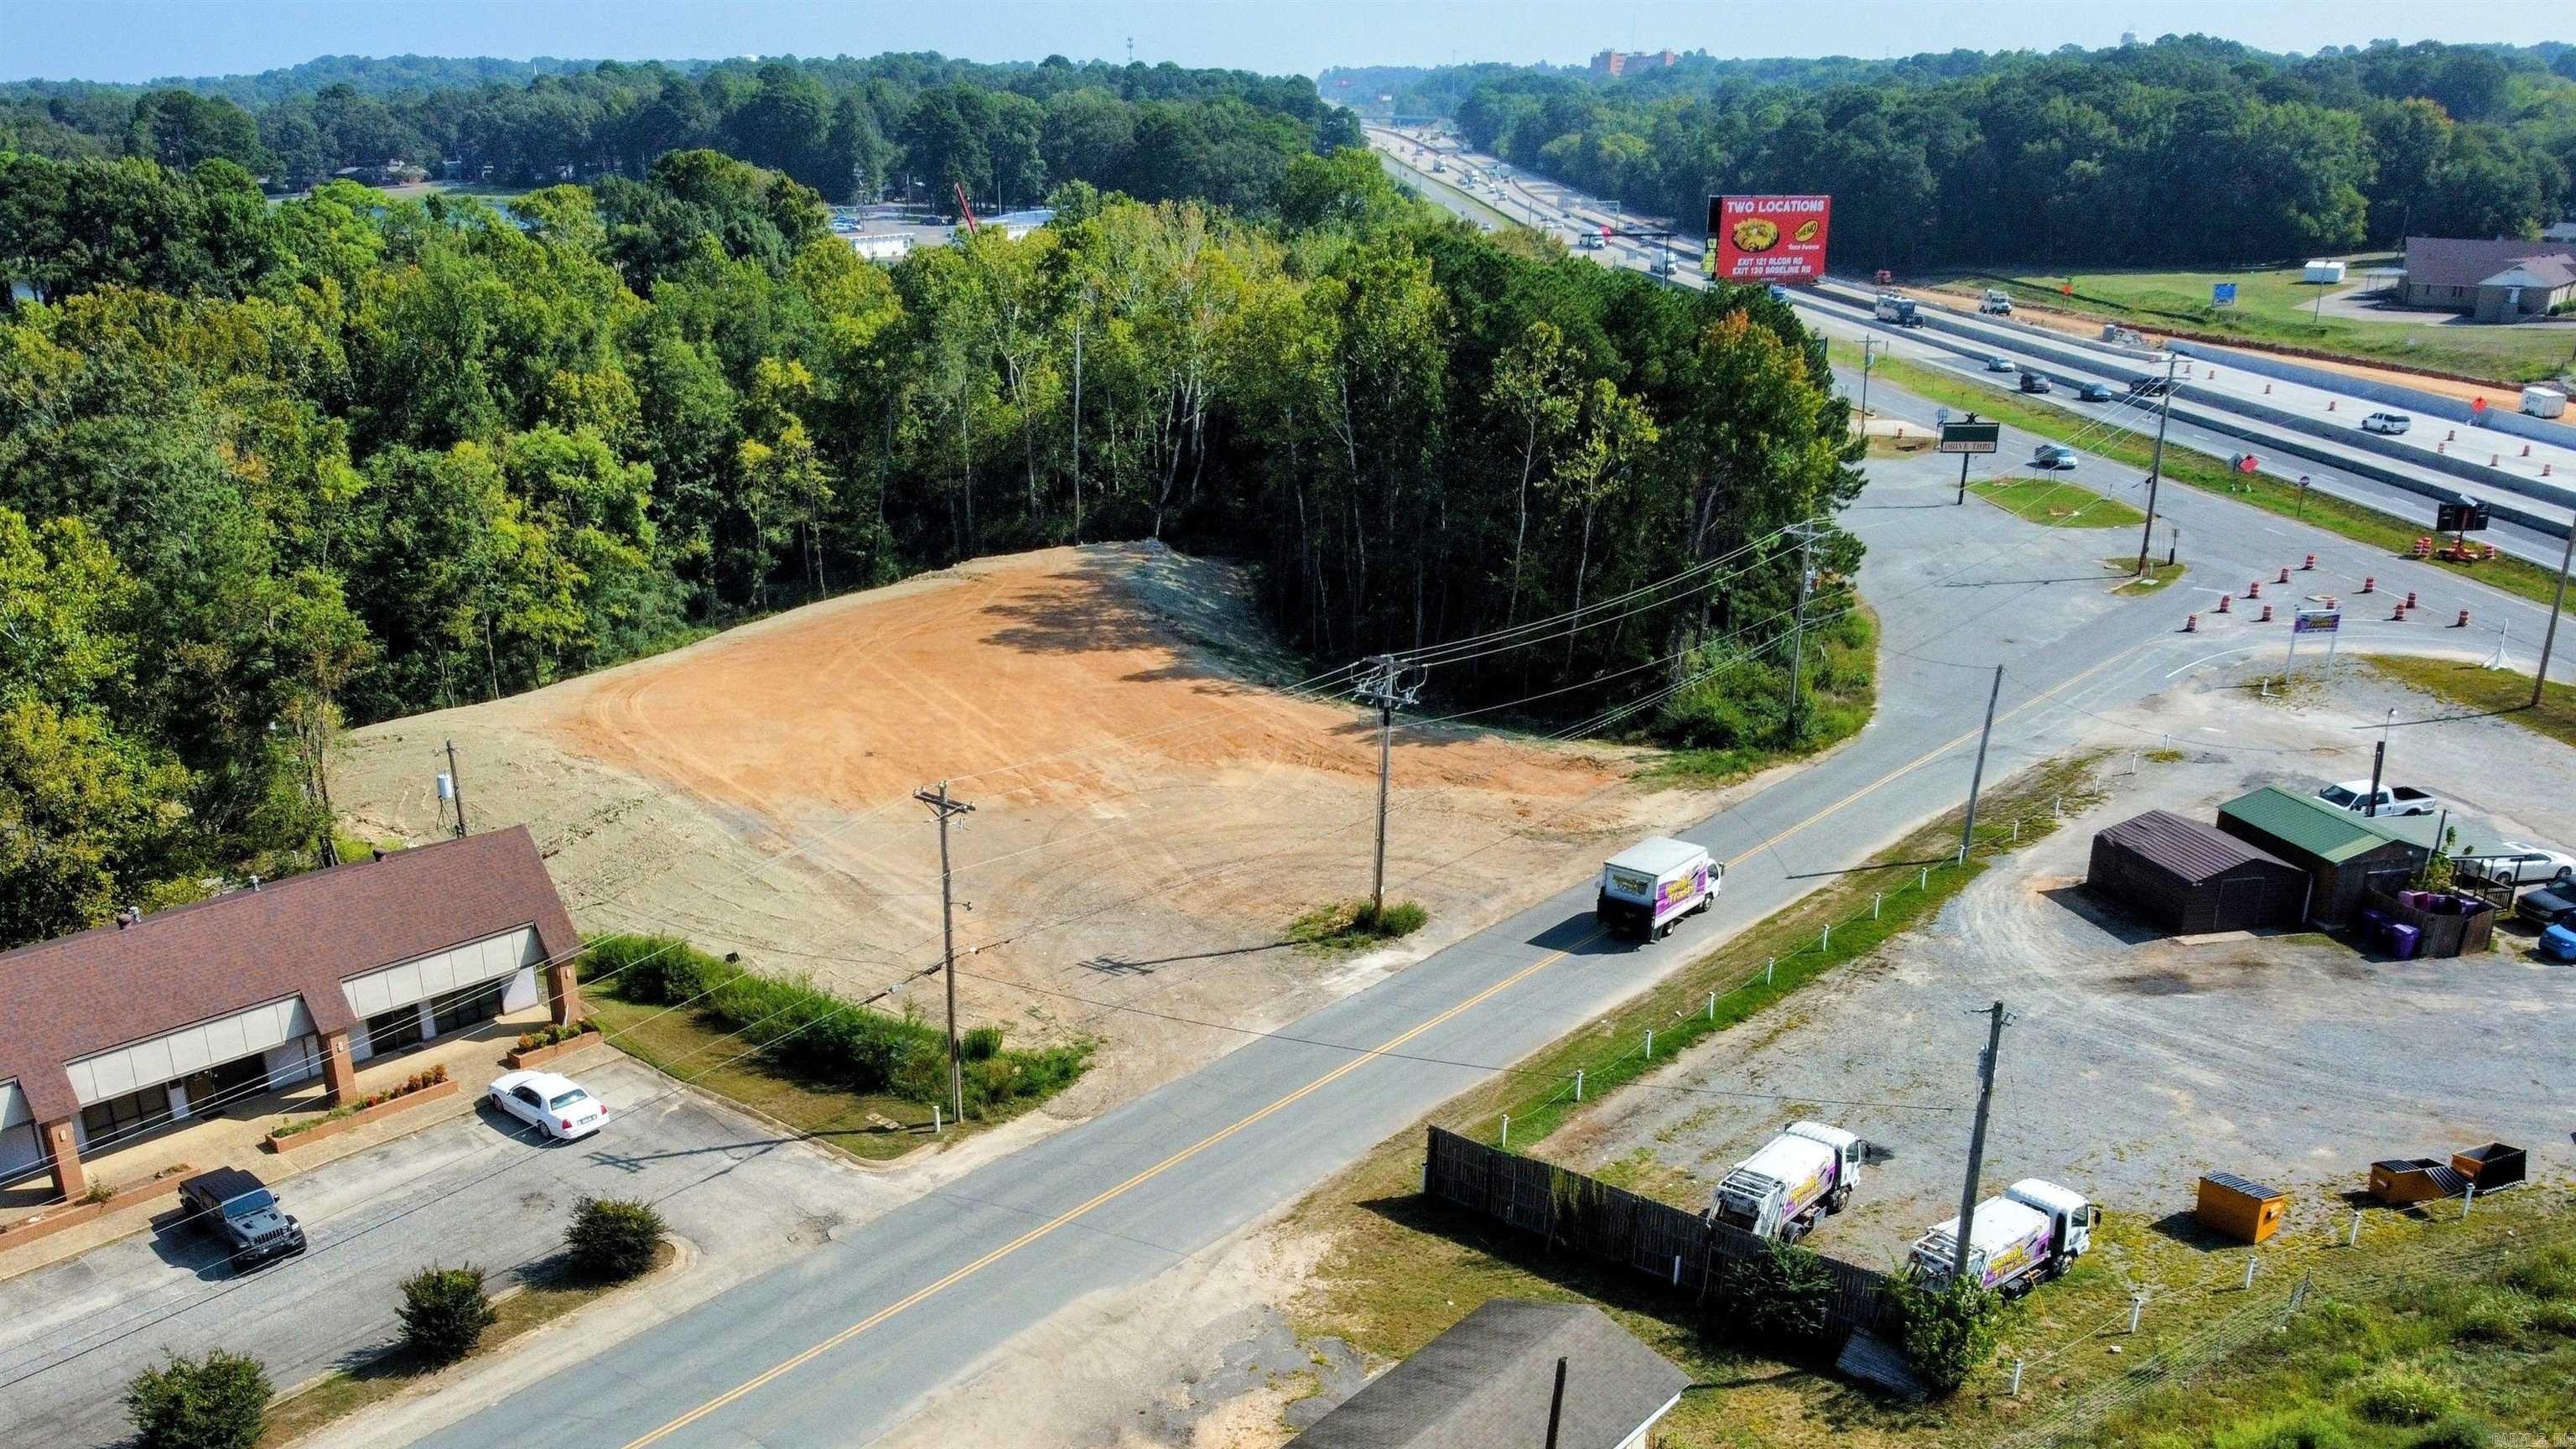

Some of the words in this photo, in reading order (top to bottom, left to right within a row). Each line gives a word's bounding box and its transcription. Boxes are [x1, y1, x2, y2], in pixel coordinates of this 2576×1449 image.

[1727, 201, 1754, 214] TWO
[1758, 200, 1825, 213] LOCATIONS
[1796, 222, 1817, 237] ENO
[1756, 257, 1767, 266] 121
[1768, 257, 1791, 266] ALCOA
[1792, 257, 1804, 265] RD
[1732, 267, 1749, 275] EXIT
[1750, 267, 1763, 275] 130
[1764, 266, 1800, 275] BASELINE
[1800, 265, 1811, 273] RD
[1945, 441, 1968, 450] DRIVE
[1971, 441, 1993, 450] THRU
